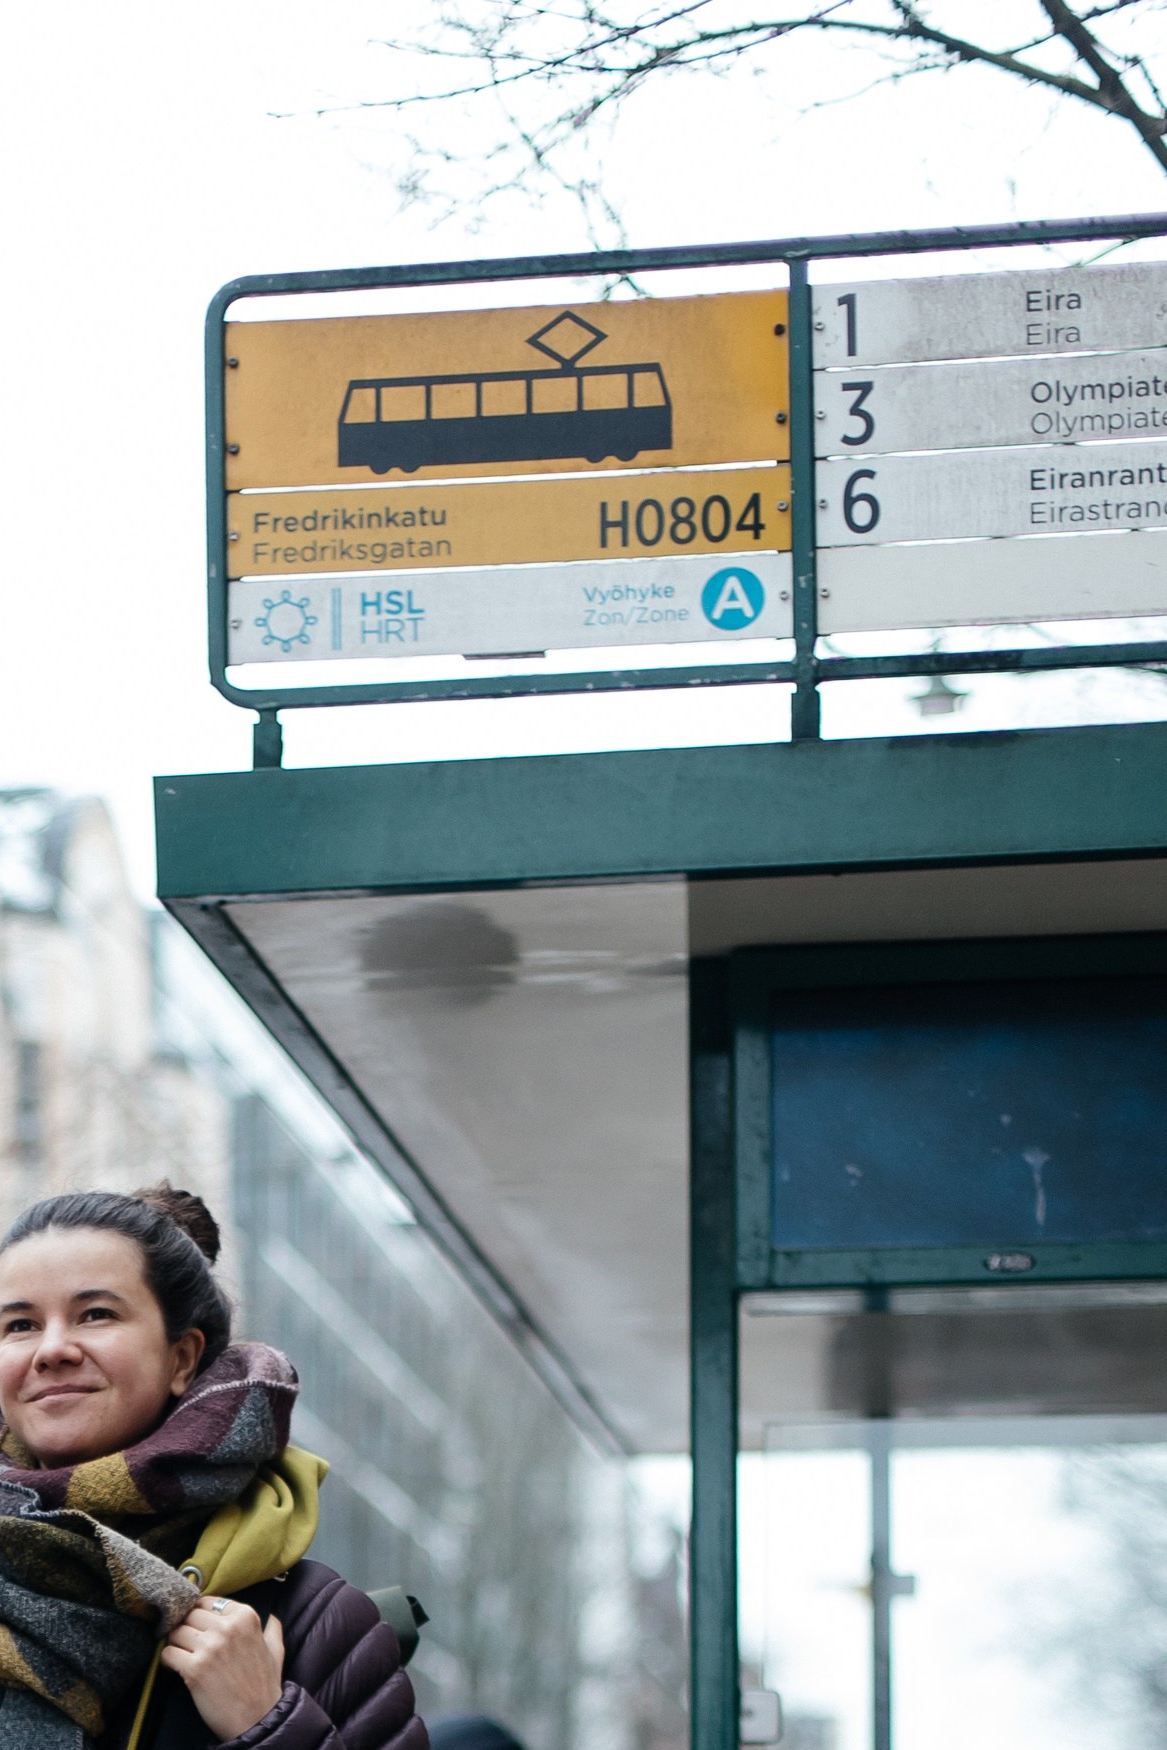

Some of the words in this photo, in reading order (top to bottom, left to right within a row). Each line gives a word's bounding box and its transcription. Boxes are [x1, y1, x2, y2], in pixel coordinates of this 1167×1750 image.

[1026, 289, 1082, 312] Eira
[837, 293, 857, 357] 1
[1026, 322, 1081, 346] Eira
[1030, 375, 1167, 406] Olympiat
[840, 381, 875, 446] 3
[843, 469, 880, 533] 6
[1030, 500, 1167, 524] Eirastran
[253, 507, 446, 533] Fredrikinkatu
[599, 493, 765, 548] H0804
[252, 538, 452, 564] Fredriksgatan
[360, 590, 425, 616] HSL
[583, 583, 675, 605] Vyöhyke
[711, 575, 755, 621] A
[584, 606, 690, 627] Zon/Zone
[360, 617, 425, 644] HRT
